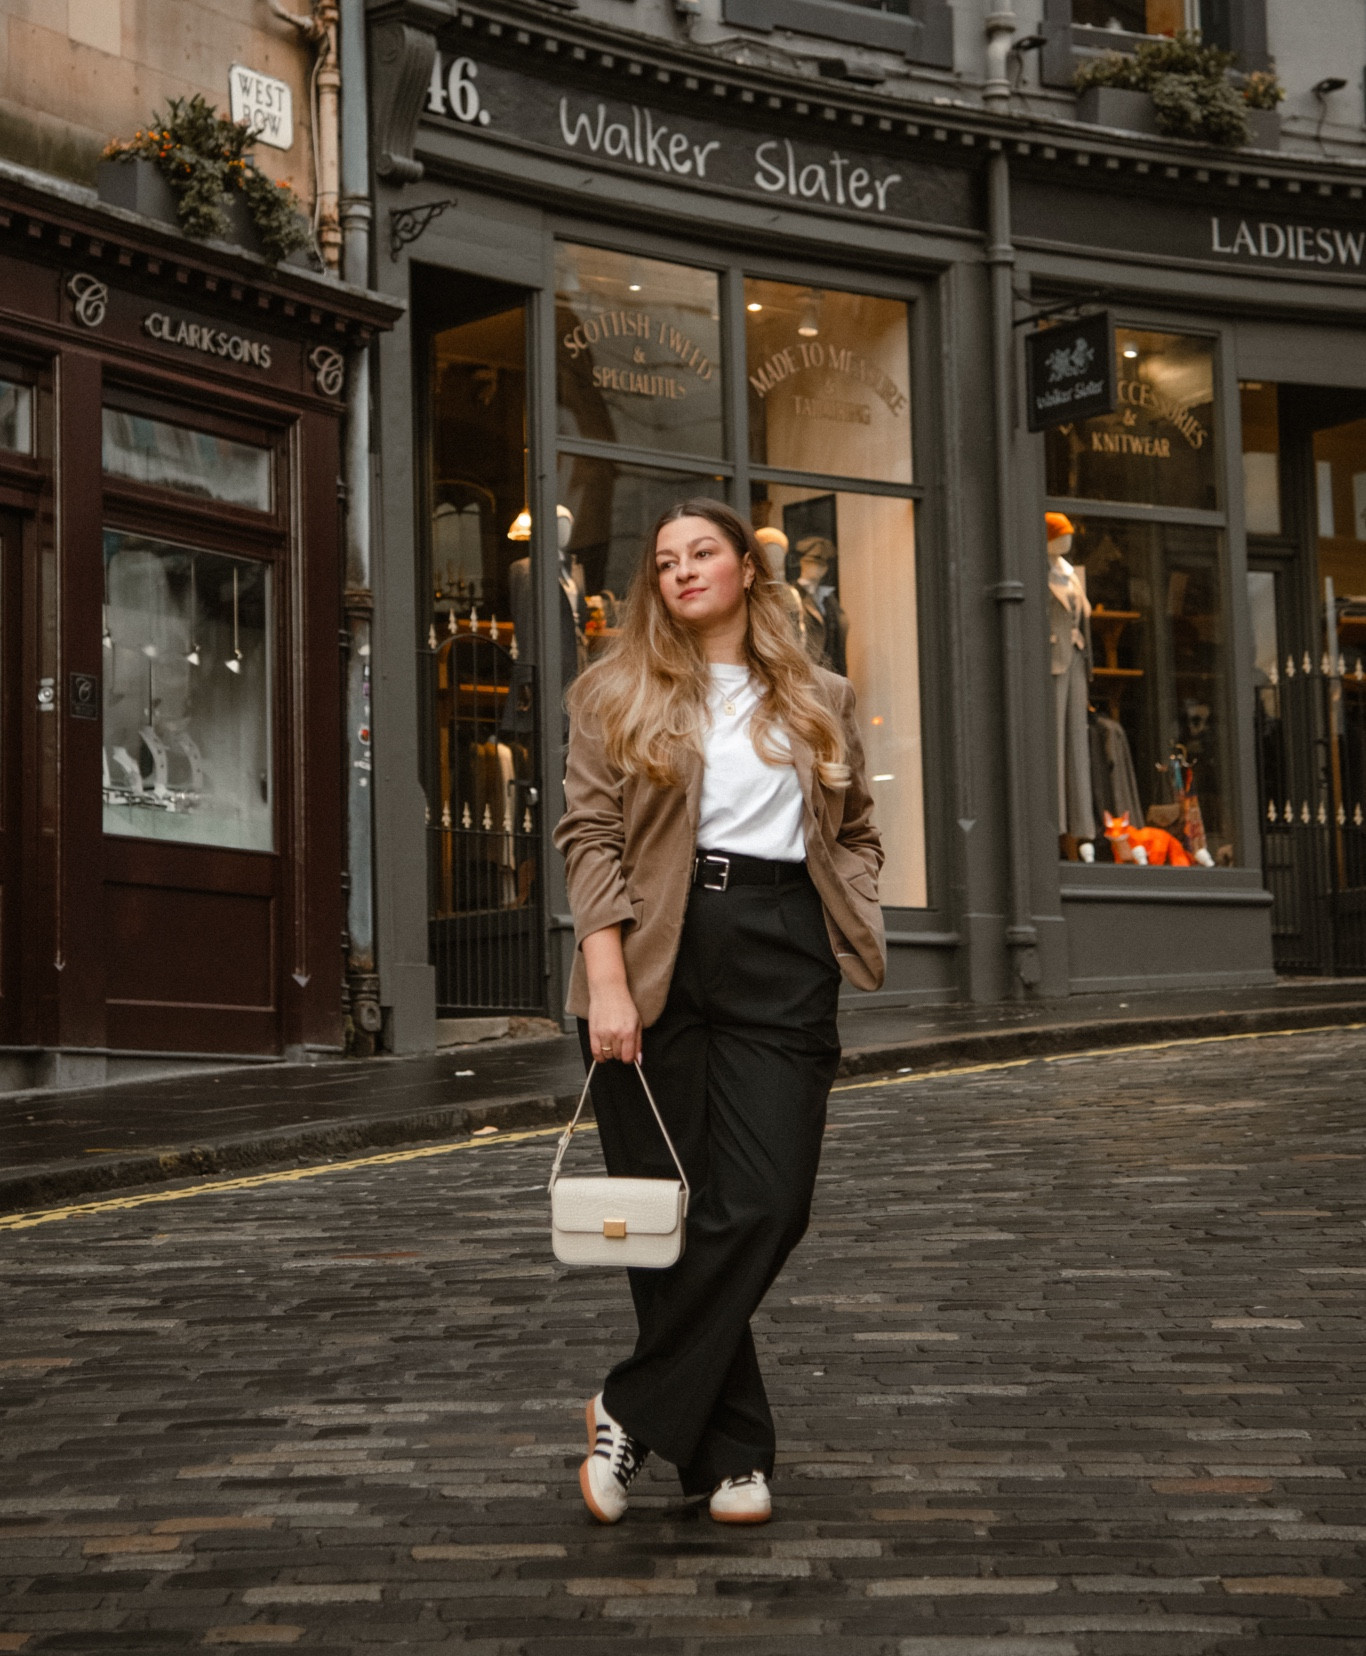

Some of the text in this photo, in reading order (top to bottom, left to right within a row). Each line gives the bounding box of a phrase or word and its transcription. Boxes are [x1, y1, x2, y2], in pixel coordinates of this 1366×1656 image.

[238, 73, 285, 112] WEST
[242, 104, 282, 136] BOW
[559, 97, 901, 211] Walker Slater
[1211, 216, 1366, 266] LADIESW
[144, 312, 271, 369] CLARKSONS
[563, 311, 651, 359] SCOTTISH
[632, 345, 646, 364] &
[592, 365, 687, 400] SPECIALITIES
[749, 345, 799, 398] MADE
[797, 341, 825, 368] TO
[1116, 379, 1208, 449] CCESORIES
[1123, 408, 1137, 427] &
[1092, 431, 1171, 458] KNITWEAR
